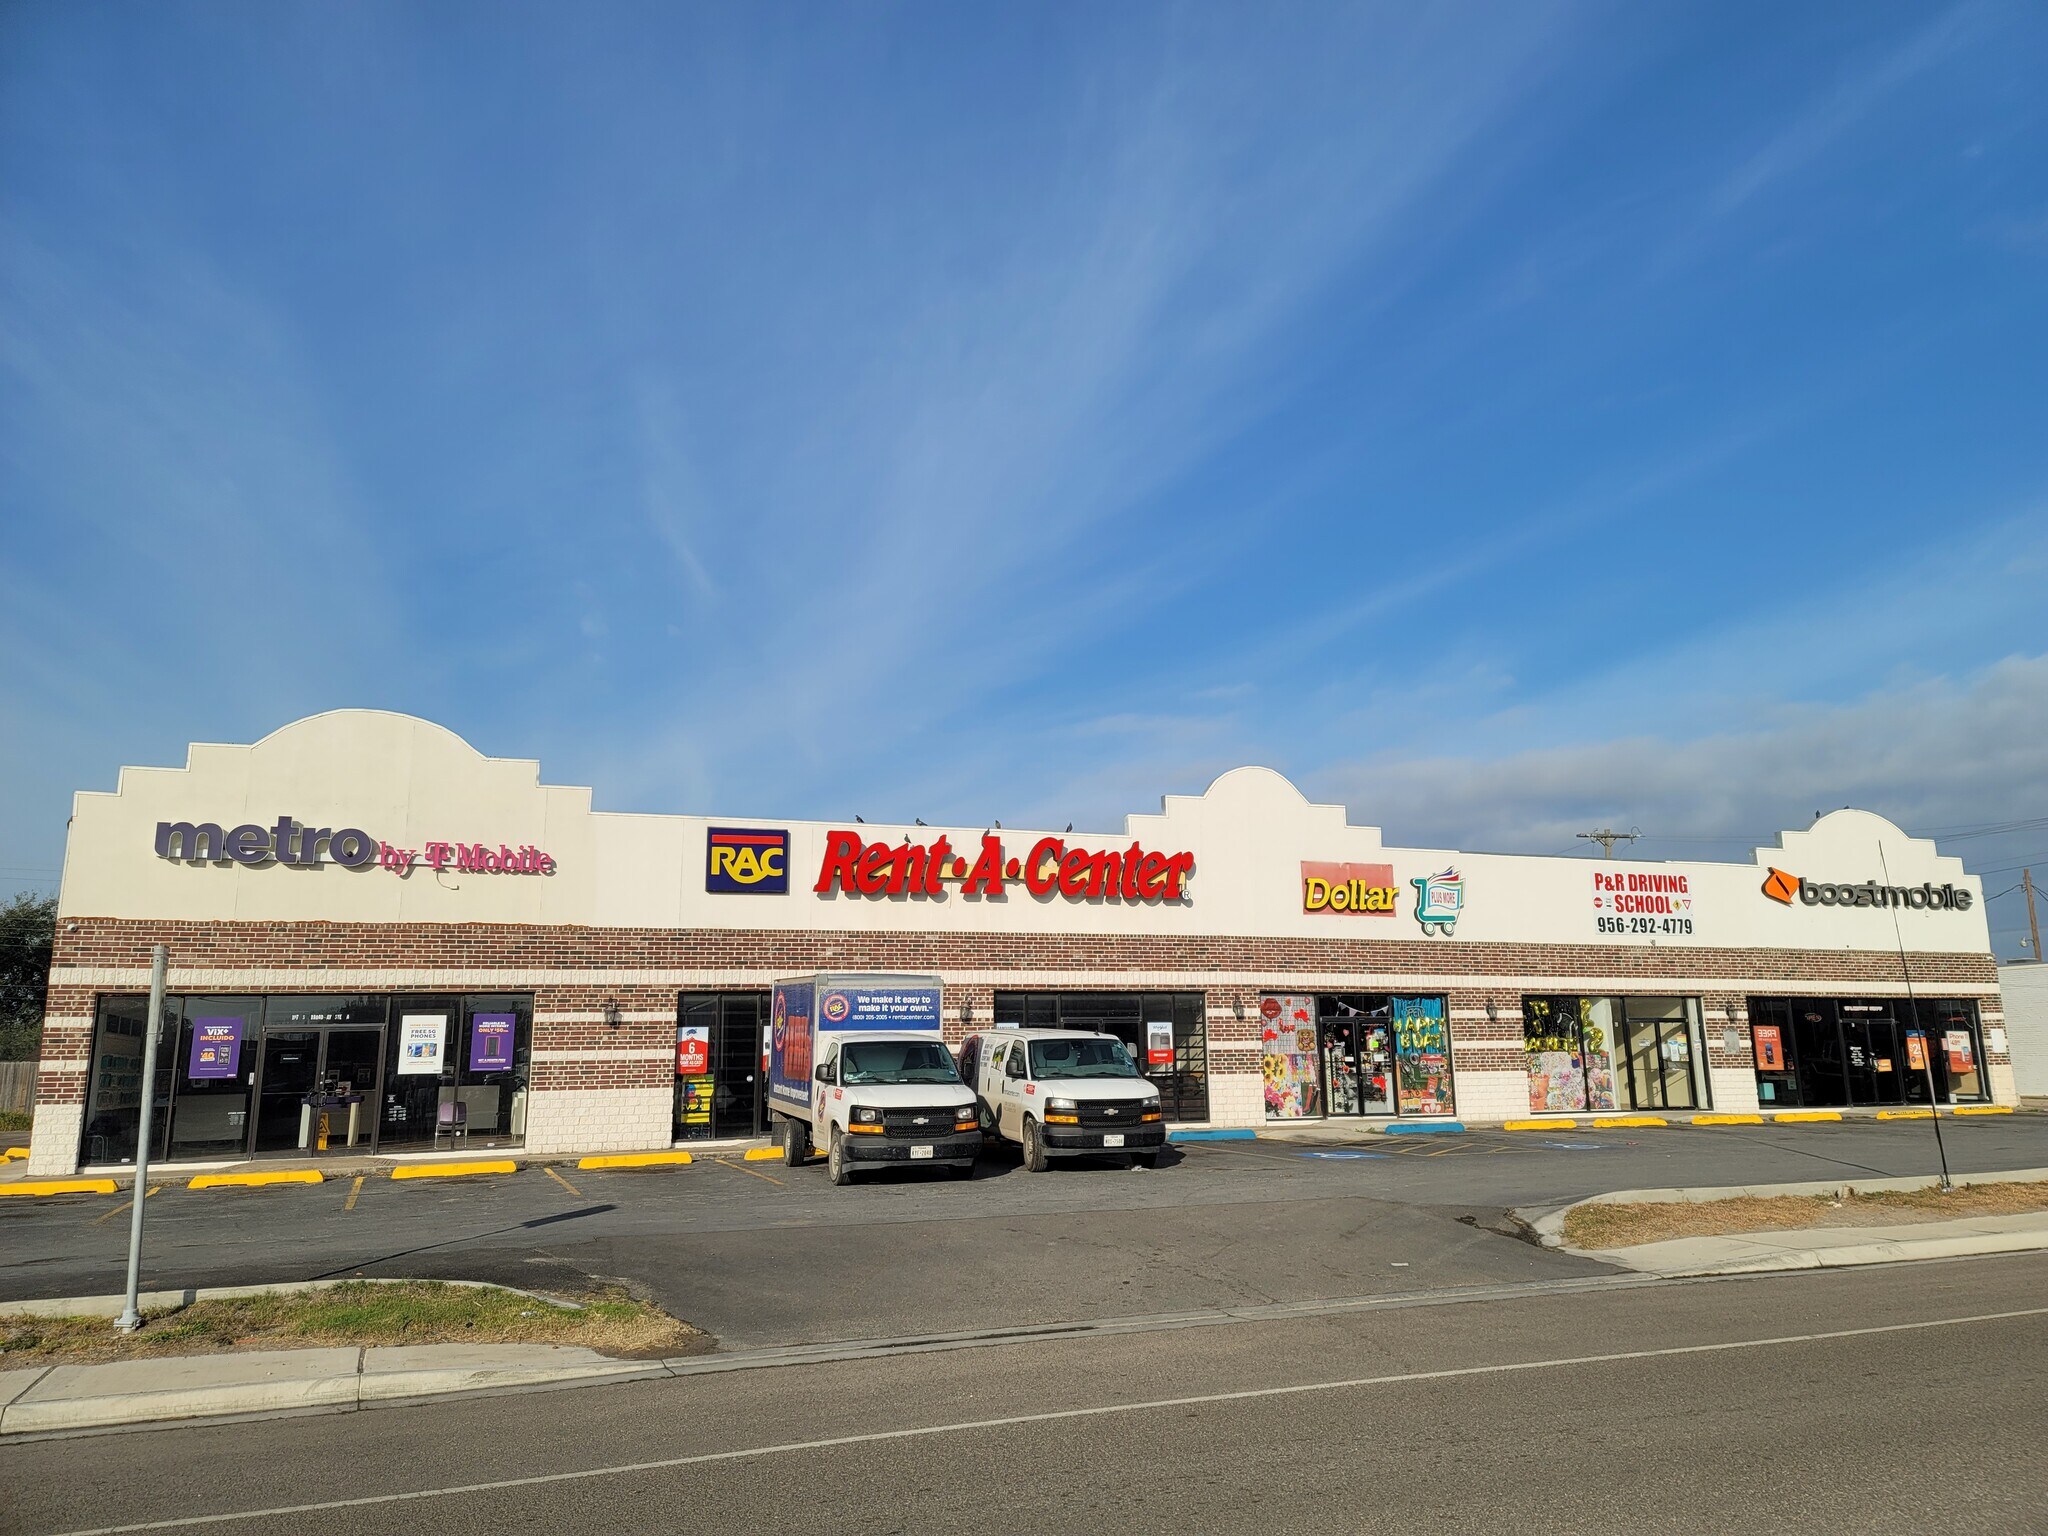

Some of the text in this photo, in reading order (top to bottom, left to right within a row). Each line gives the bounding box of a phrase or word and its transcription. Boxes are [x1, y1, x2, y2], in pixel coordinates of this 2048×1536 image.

[154, 816, 372, 867] metro
[379, 841, 416, 875] by
[455, 842, 552, 872] Mobile
[711, 846, 783, 884] RAC
[1594, 873, 1688, 893] P&R DRIVING
[1306, 877, 1399, 911] Dollar
[1431, 891, 1456, 904] PLUS MORE
[1614, 894, 1673, 914] SCHOOL
[1597, 917, 1693, 934] 956-292-4779
[688, 1042, 696, 1054] 6
